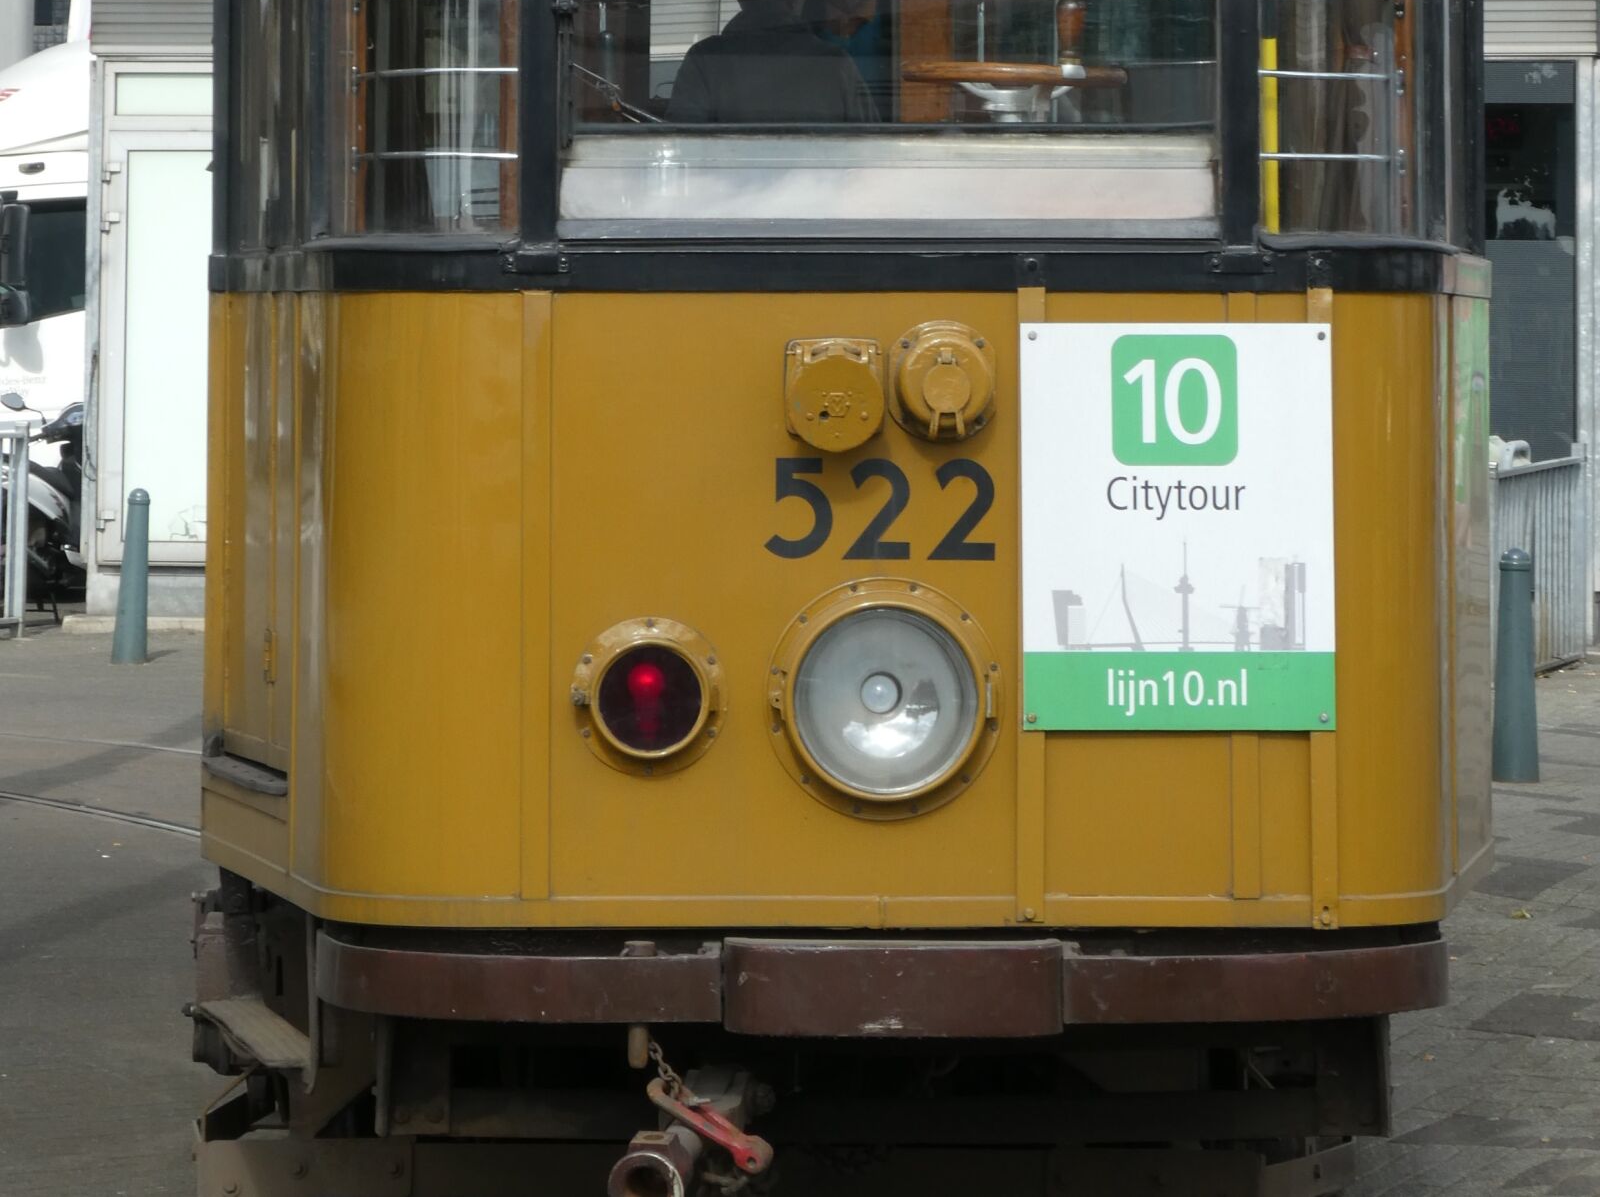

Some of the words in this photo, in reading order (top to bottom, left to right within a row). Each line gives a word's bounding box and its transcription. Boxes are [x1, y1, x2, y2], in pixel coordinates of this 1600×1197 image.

[1123, 357, 1222, 445] 10
[764, 457, 996, 561] 522
[1106, 475, 1246, 521] Citytour
[1107, 668, 1248, 717] lijn10.nl
